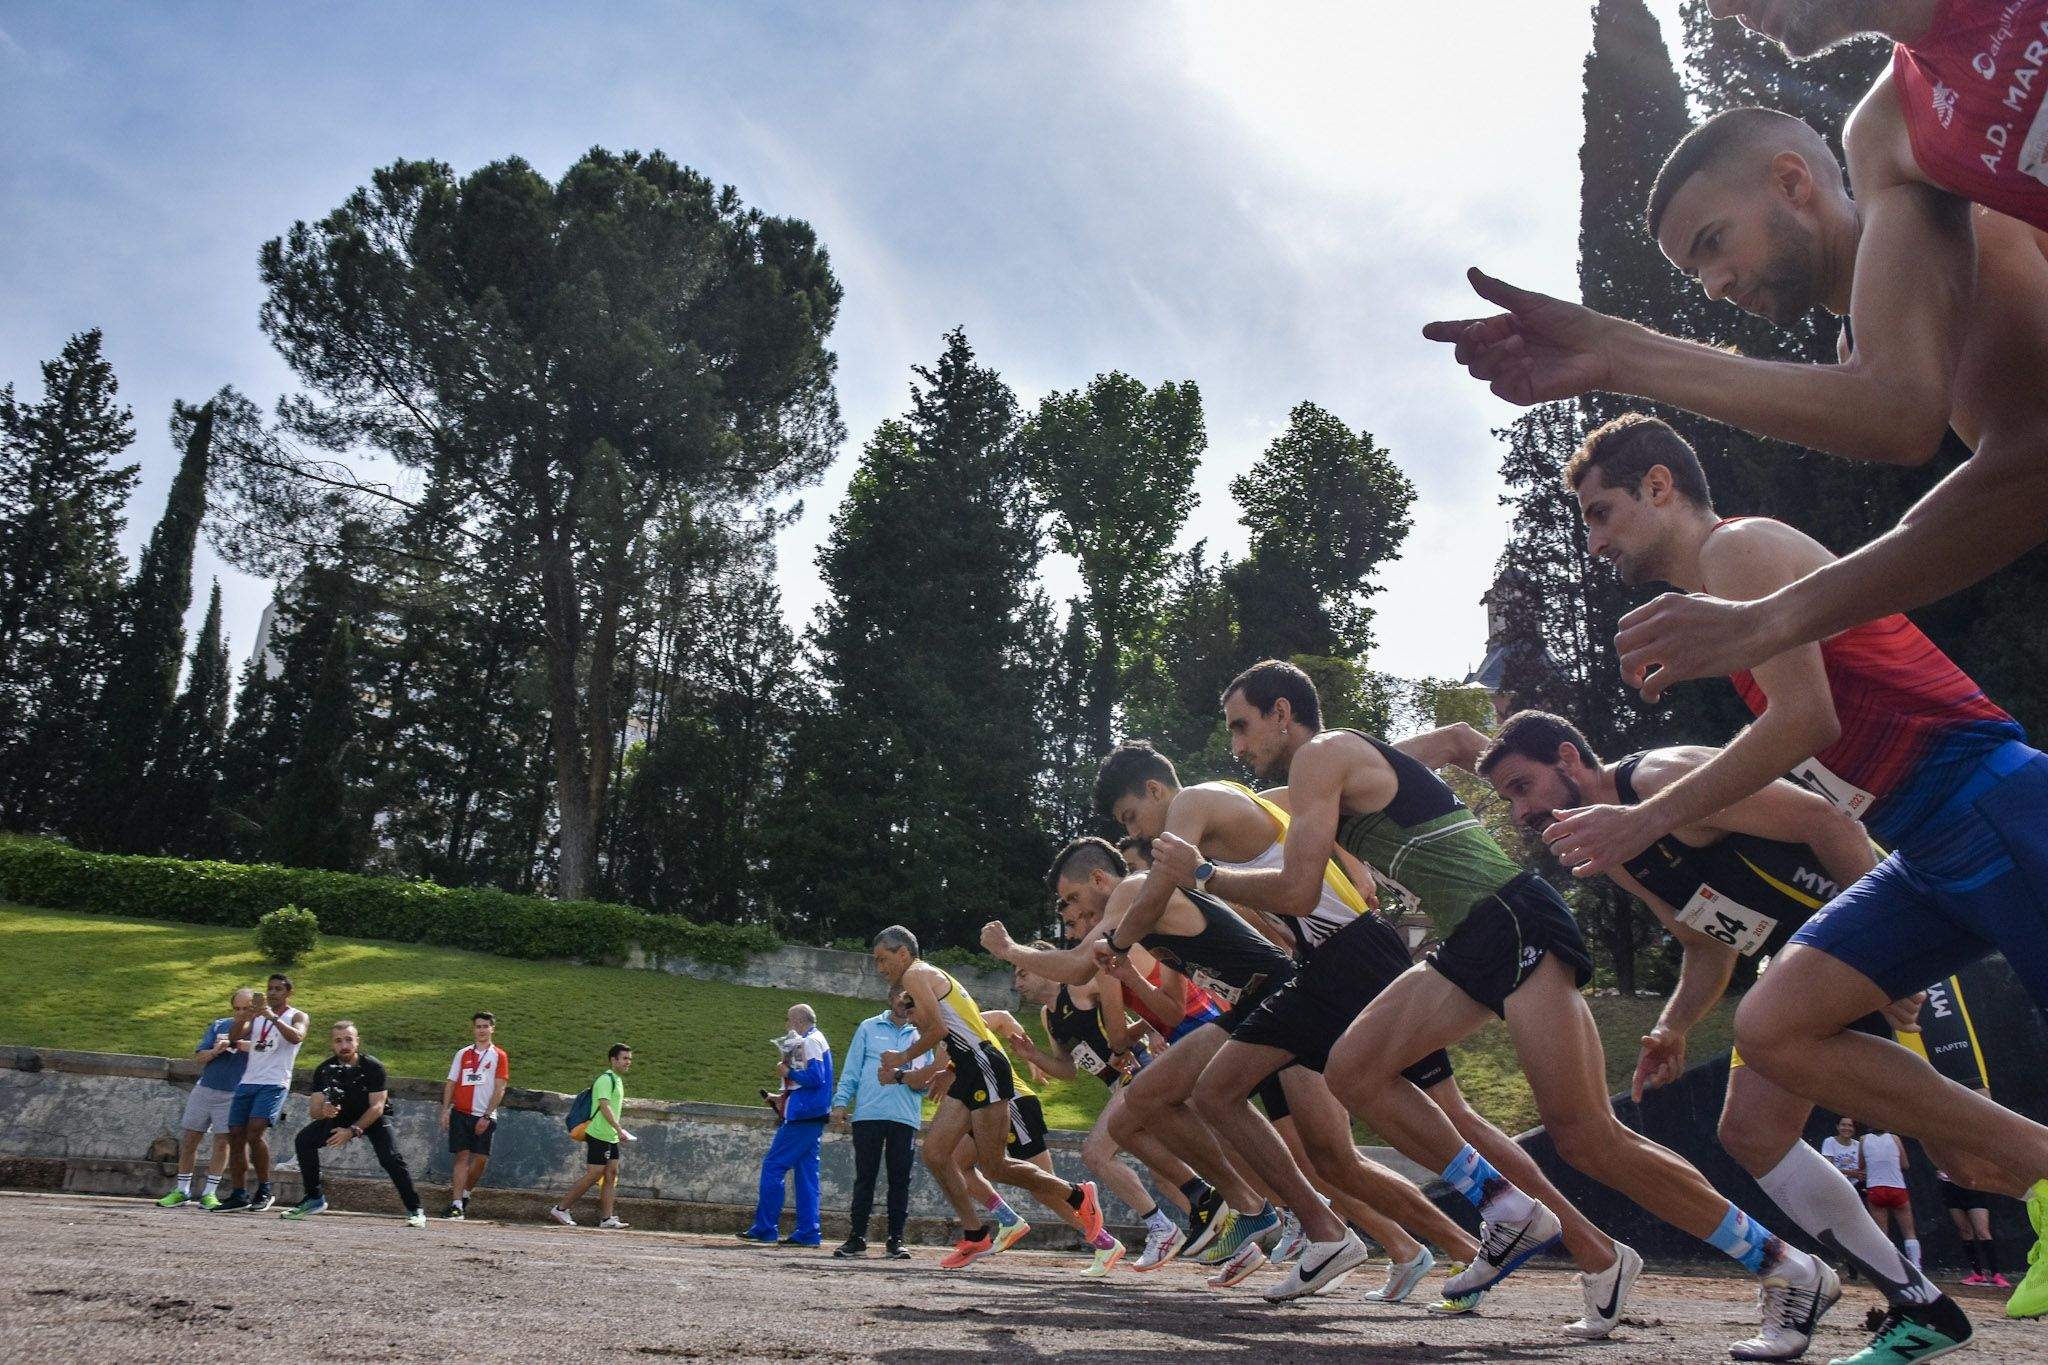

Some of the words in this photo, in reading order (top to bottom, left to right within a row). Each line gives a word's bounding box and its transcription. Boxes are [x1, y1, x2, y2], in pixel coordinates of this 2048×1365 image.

[1980, 122, 2013, 174] A.D.
[1848, 793, 1866, 810] 2023
[1704, 911, 1748, 945] 64
[1753, 920, 1770, 937] 2023
